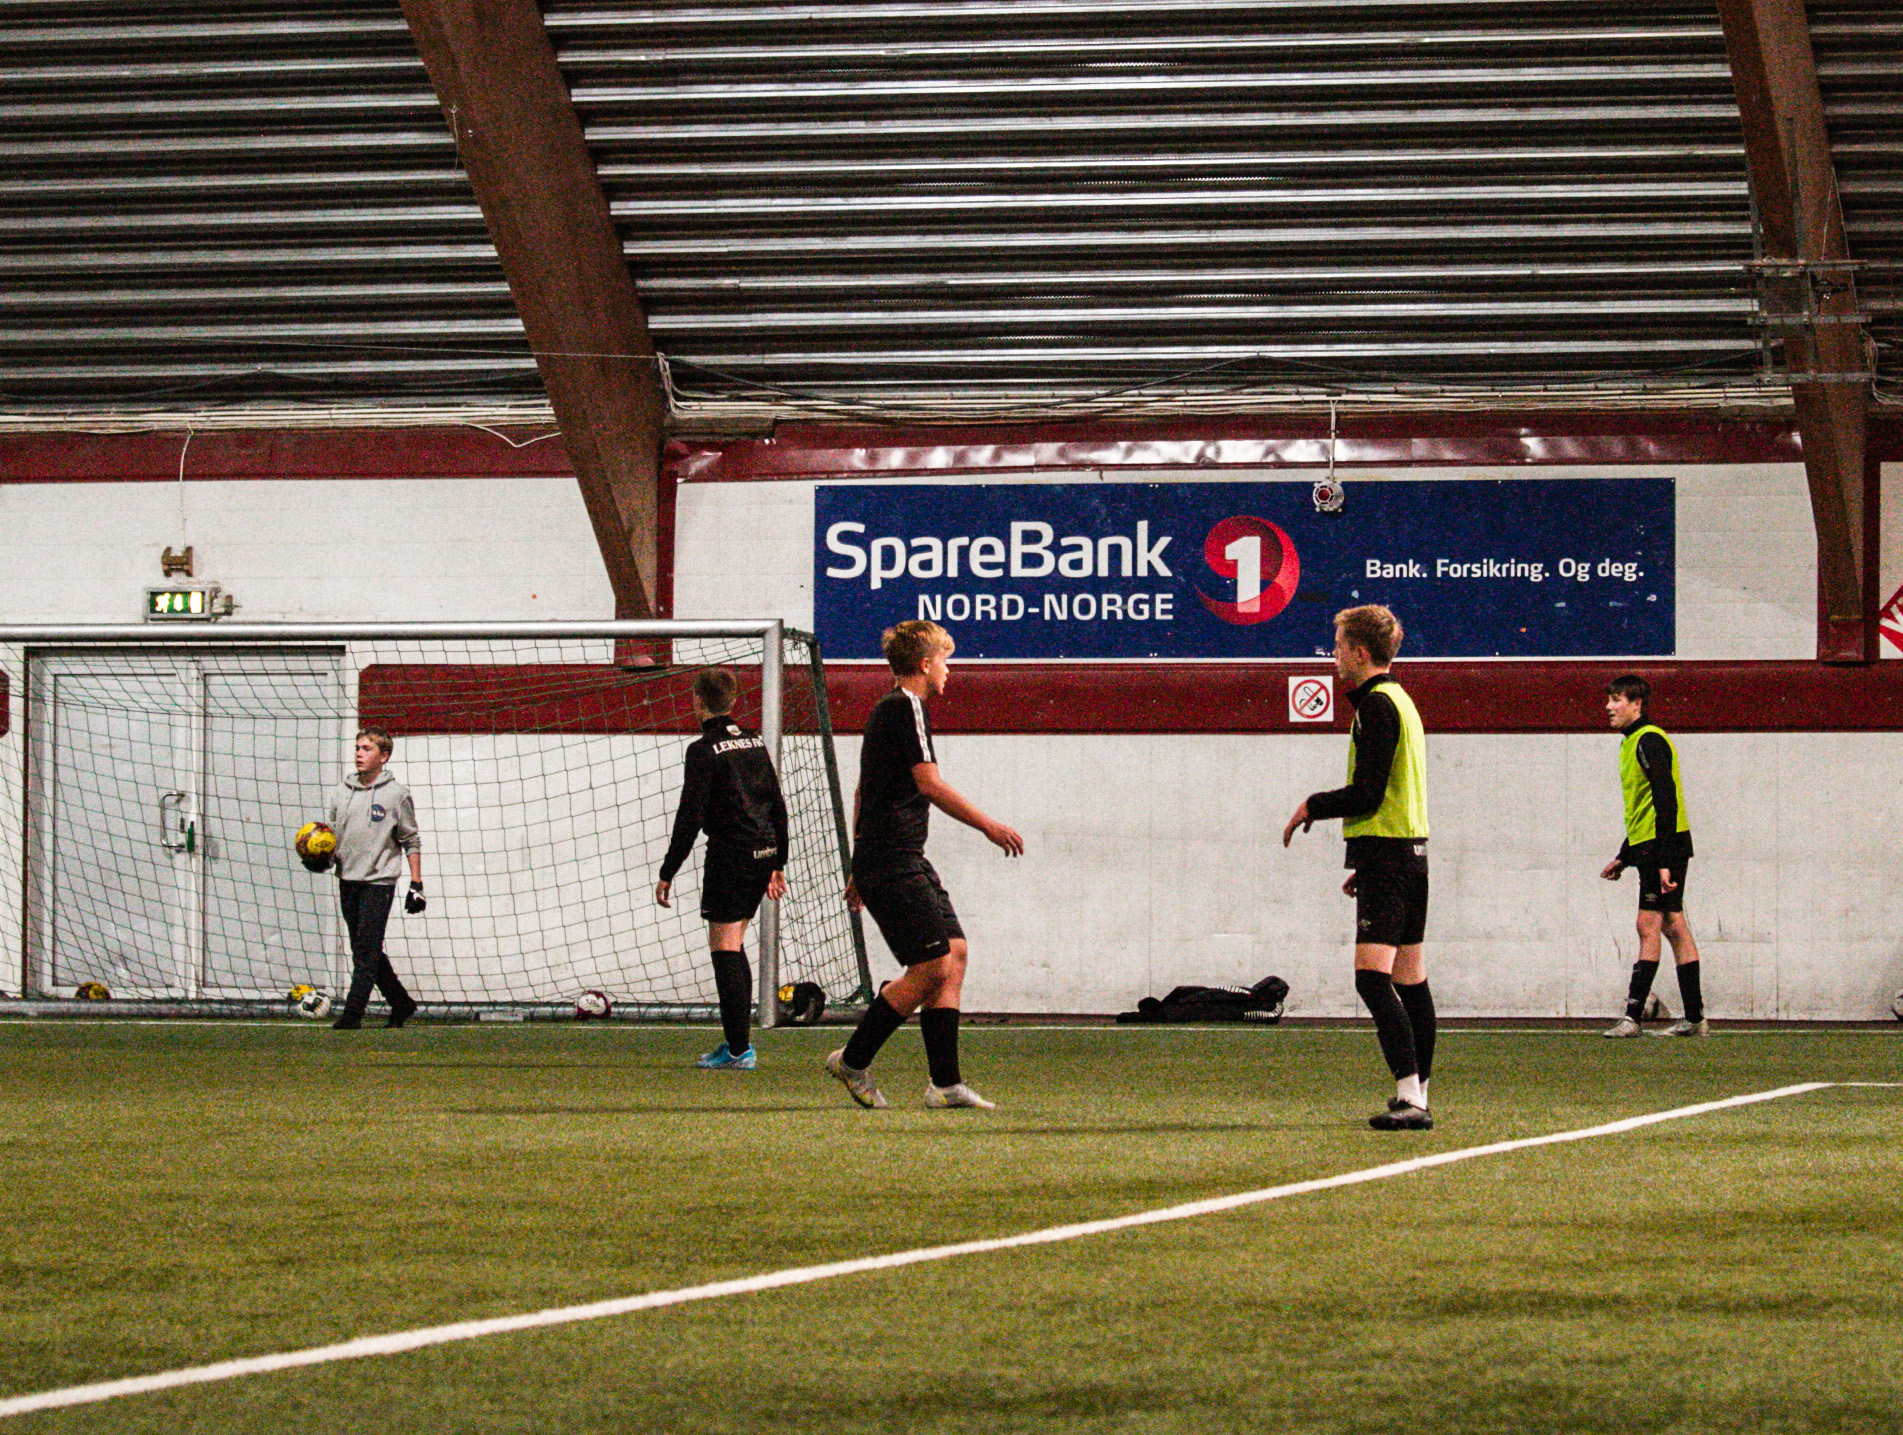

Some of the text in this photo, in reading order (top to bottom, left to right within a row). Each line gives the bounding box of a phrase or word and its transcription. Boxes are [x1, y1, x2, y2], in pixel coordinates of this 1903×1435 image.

[825, 519, 1261, 613] SpareBank 1
[1365, 557, 1645, 582] Bank. Forsikring. Og deg.
[918, 593, 1174, 621] NORD-NORGE
[712, 738, 753, 755] LEKNES
